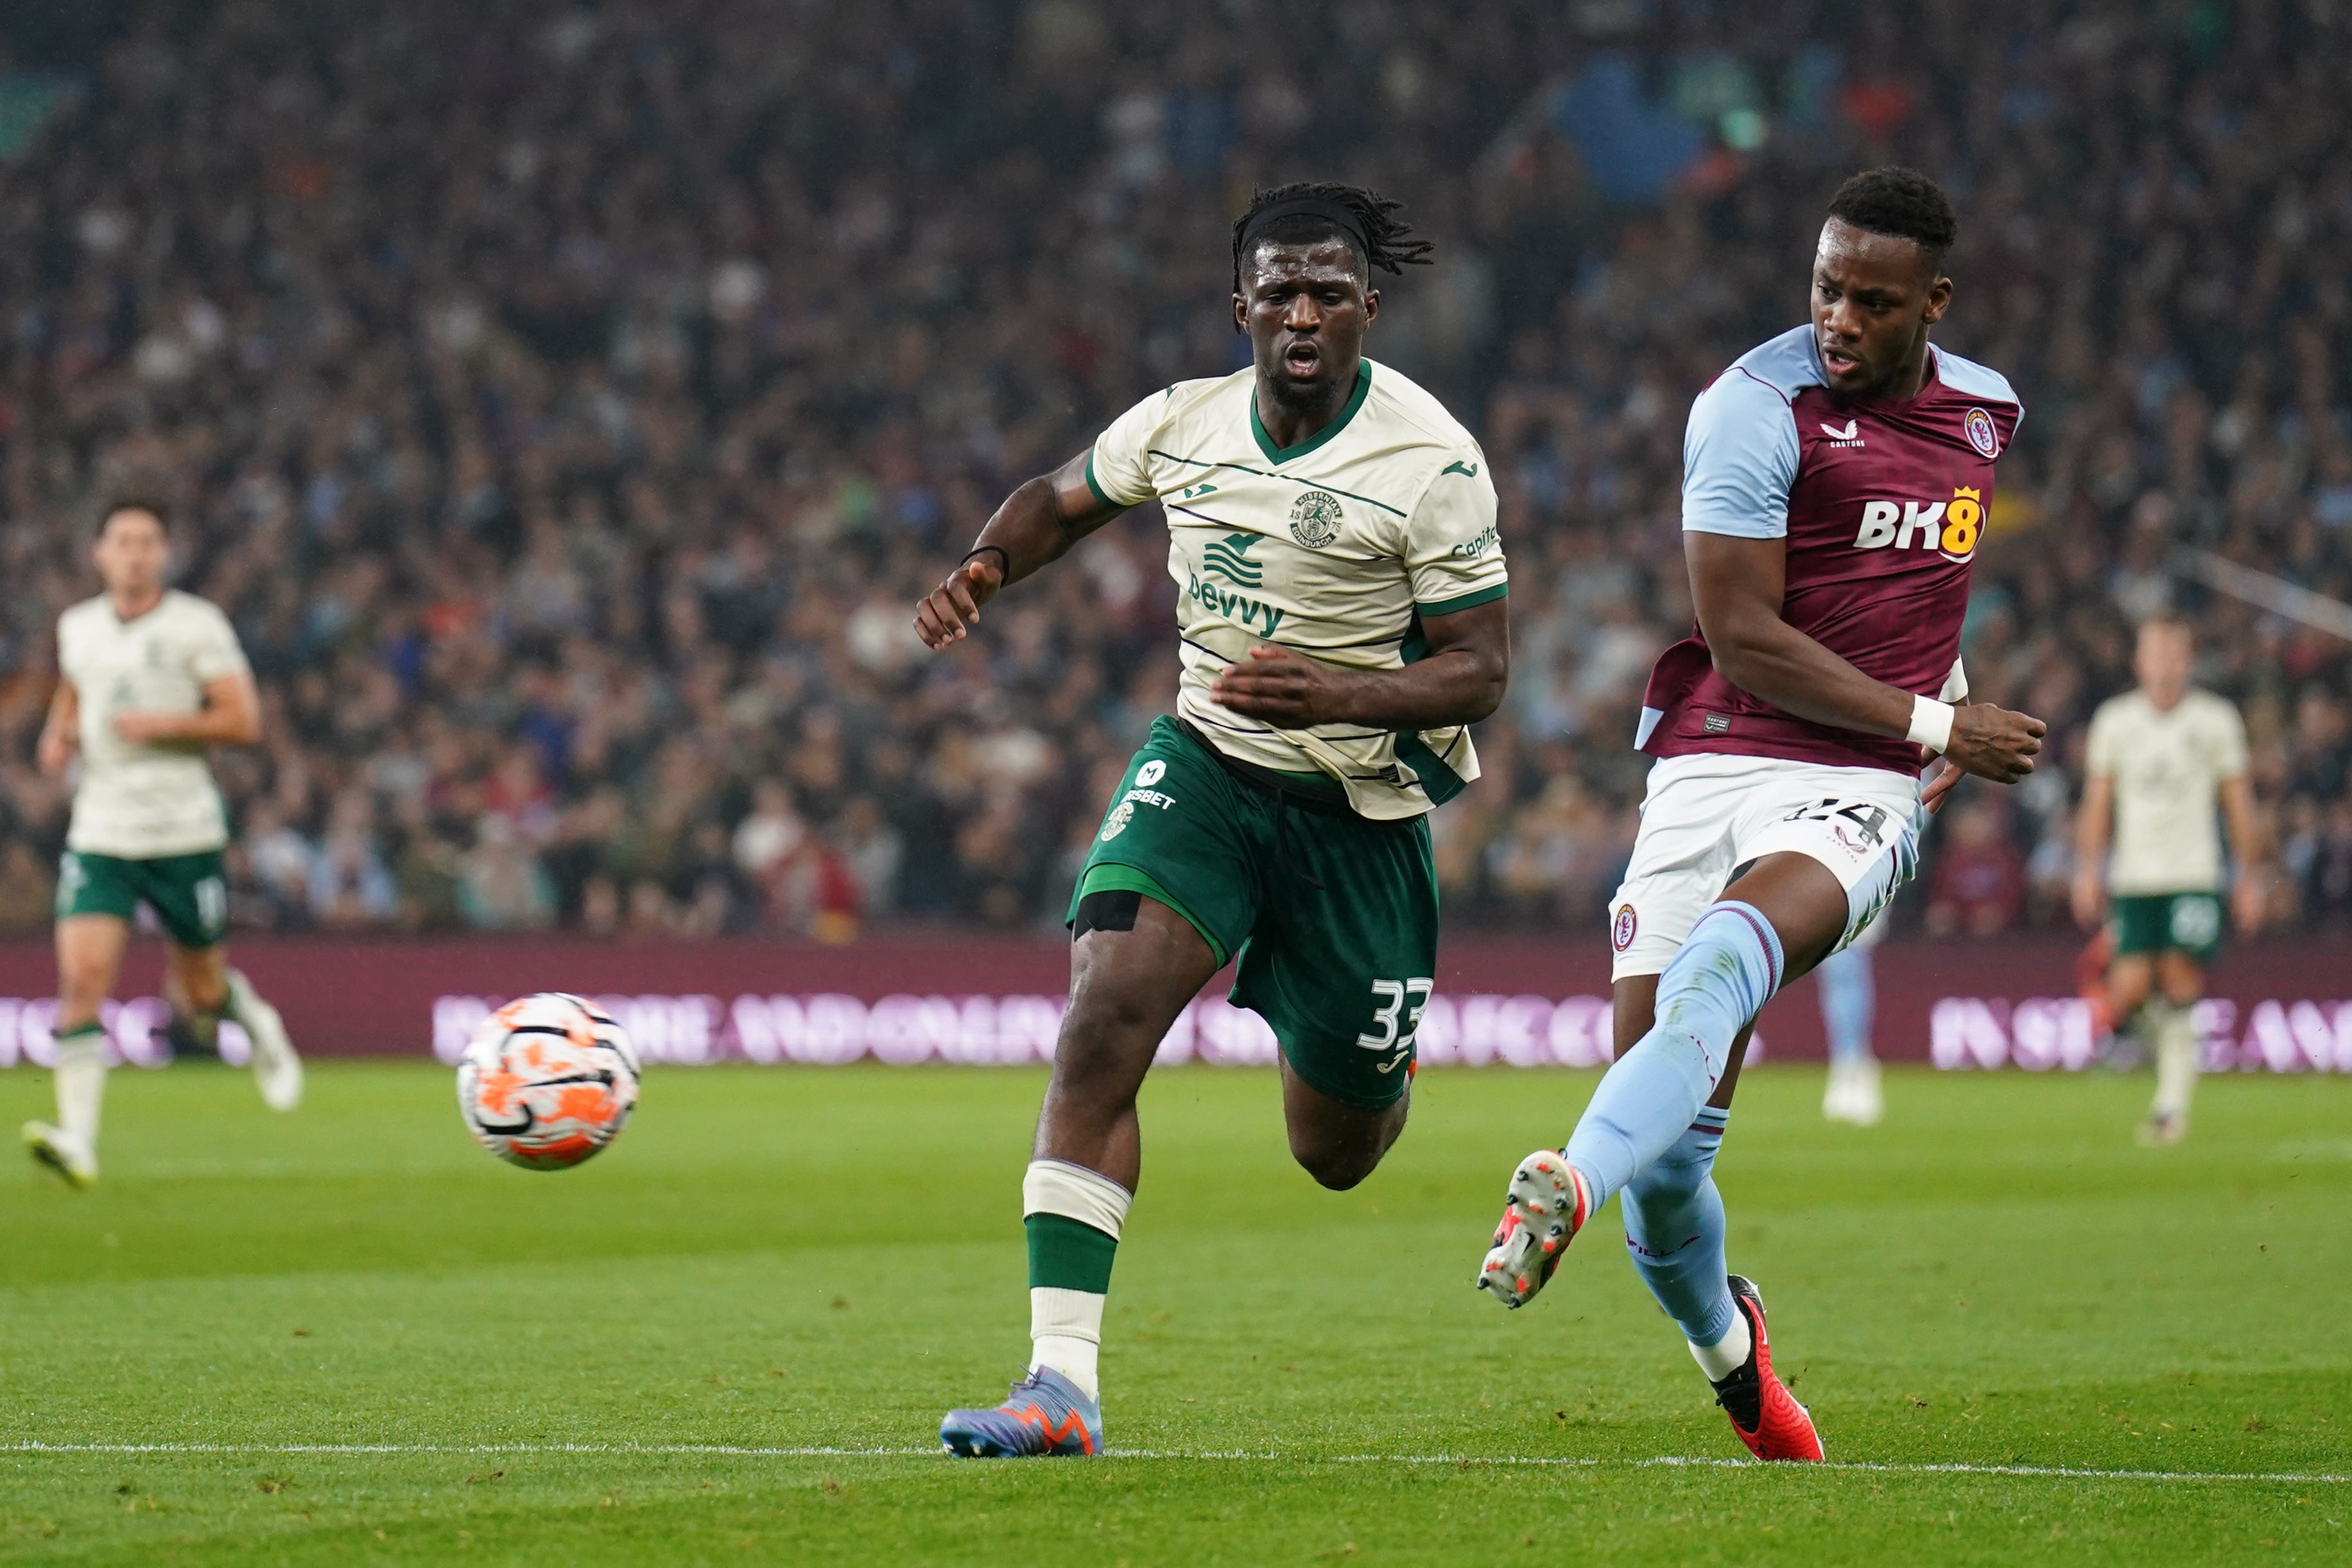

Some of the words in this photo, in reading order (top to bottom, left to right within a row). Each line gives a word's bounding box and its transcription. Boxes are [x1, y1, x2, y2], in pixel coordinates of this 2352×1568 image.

[1297, 492, 1341, 515] HIBERNIAN
[1853, 499, 1981, 553] BK8
[1292, 526, 1333, 548] EDINBURGH
[1187, 559, 1285, 638] bevvy
[1356, 976, 1435, 1051] 33
